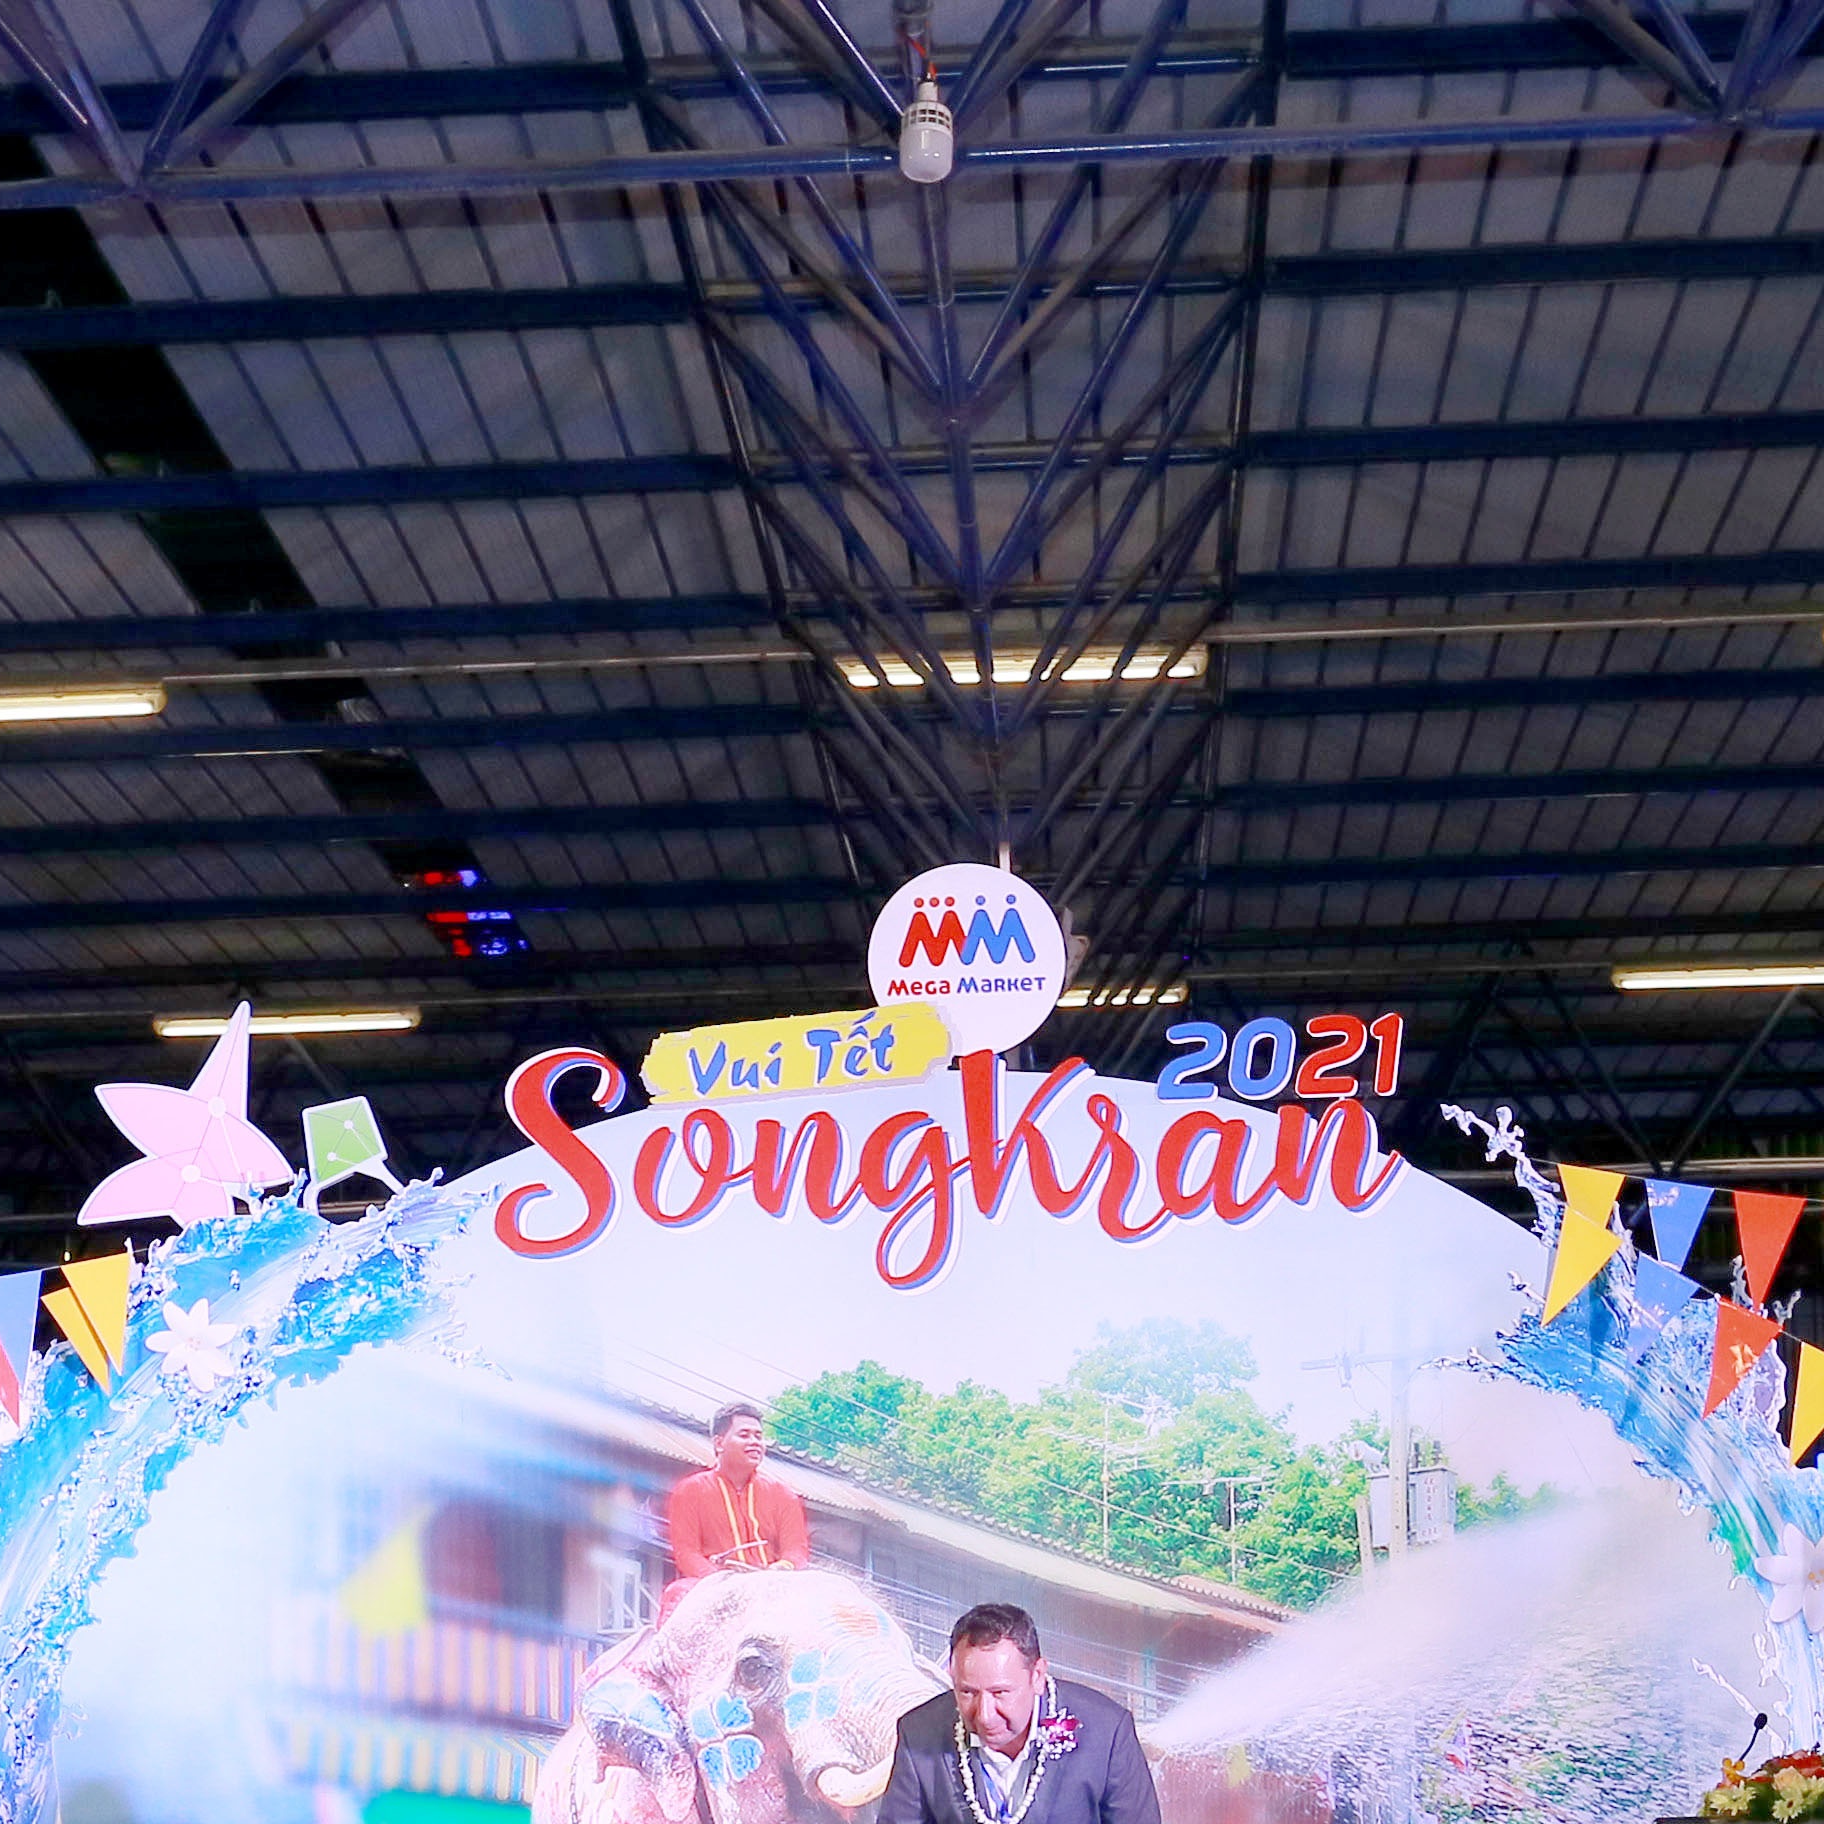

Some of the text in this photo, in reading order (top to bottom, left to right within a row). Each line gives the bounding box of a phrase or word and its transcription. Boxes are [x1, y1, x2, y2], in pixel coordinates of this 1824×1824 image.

[688, 1010, 895, 1096] Vui Tết
[1157, 1012, 1404, 1102] 2021
